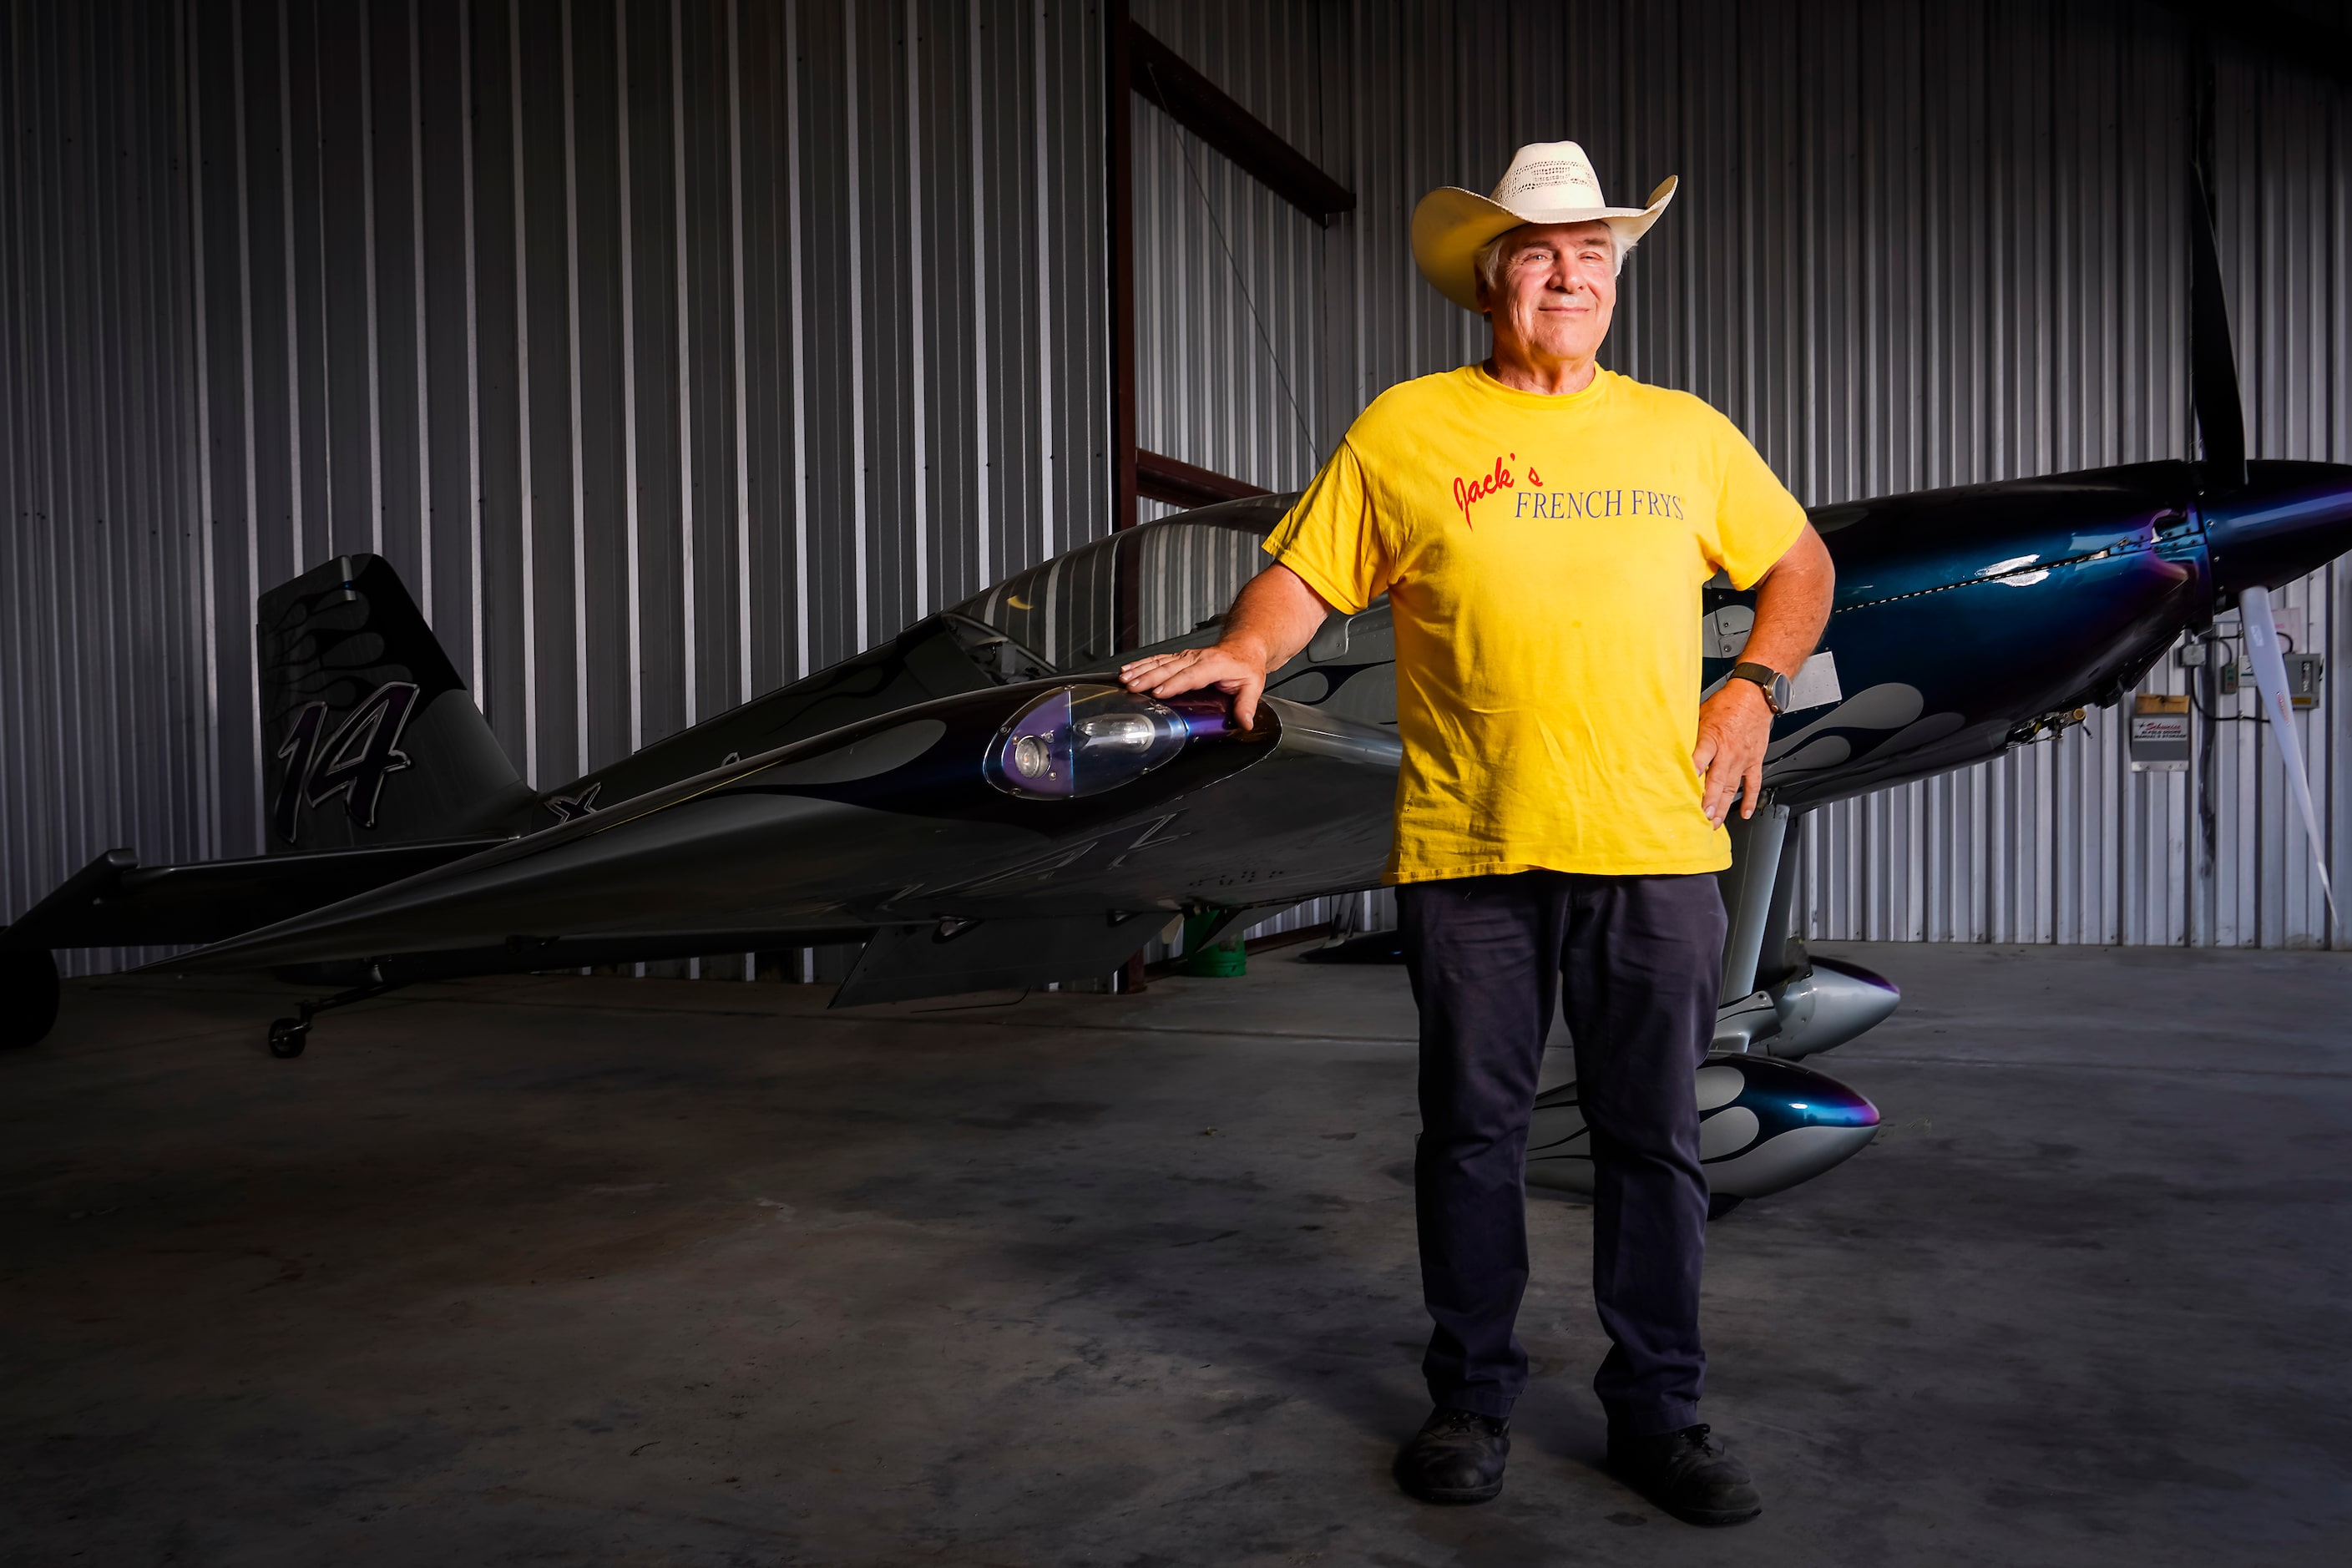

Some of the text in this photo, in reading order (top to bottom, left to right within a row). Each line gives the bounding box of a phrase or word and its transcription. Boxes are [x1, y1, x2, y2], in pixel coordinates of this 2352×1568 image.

[1453, 453, 1543, 532] Jack's
[1514, 489, 1684, 520] FRENCH FRYS
[275, 680, 419, 844] 14
